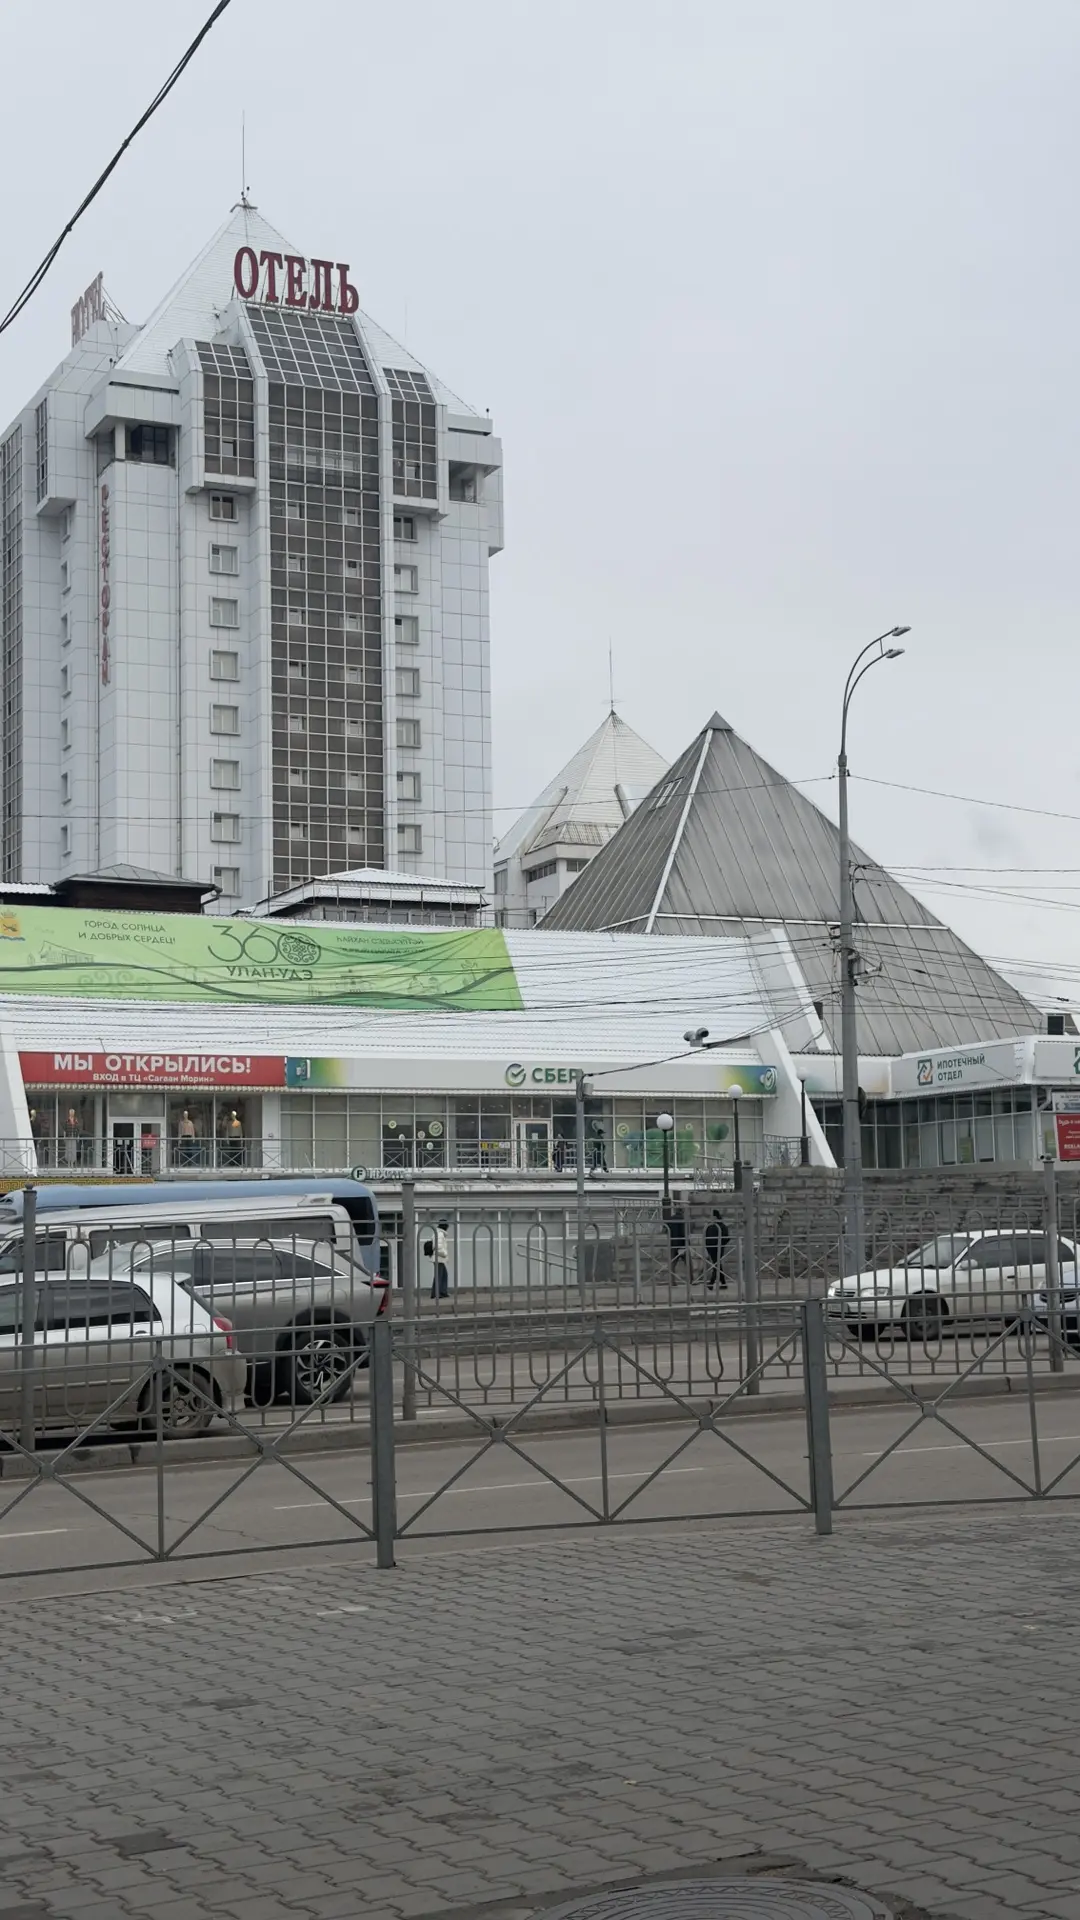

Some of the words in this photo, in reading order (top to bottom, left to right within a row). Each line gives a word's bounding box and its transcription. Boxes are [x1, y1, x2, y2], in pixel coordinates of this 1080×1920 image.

[234, 246, 359, 314] ОТЕЛЬ
[101, 484, 111, 688] РЕСТОРАН
[84, 920, 119, 930] ГОРОД
[121, 923, 166, 932] СОЛНЦА
[90, 933, 131, 942] ДОБРЫХ
[133, 935, 176, 945] СЕРДЕЦ!
[226, 966, 313, 981] УЛАН-УДЭ
[54, 1054, 93, 1071] МЫ
[105, 1055, 251, 1074] ОТКРЫЛИСЬ!
[937, 1053, 986, 1070] ИПОТЕЧНЫЙ
[93, 1073, 119, 1082] ВХОД
[129, 1074, 142, 1082] ТЦ
[143, 1074, 179, 1082] «Сагаан
[181, 1075, 214, 1084] Морин»
[938, 1070, 963, 1081] ОТДЕЛ
